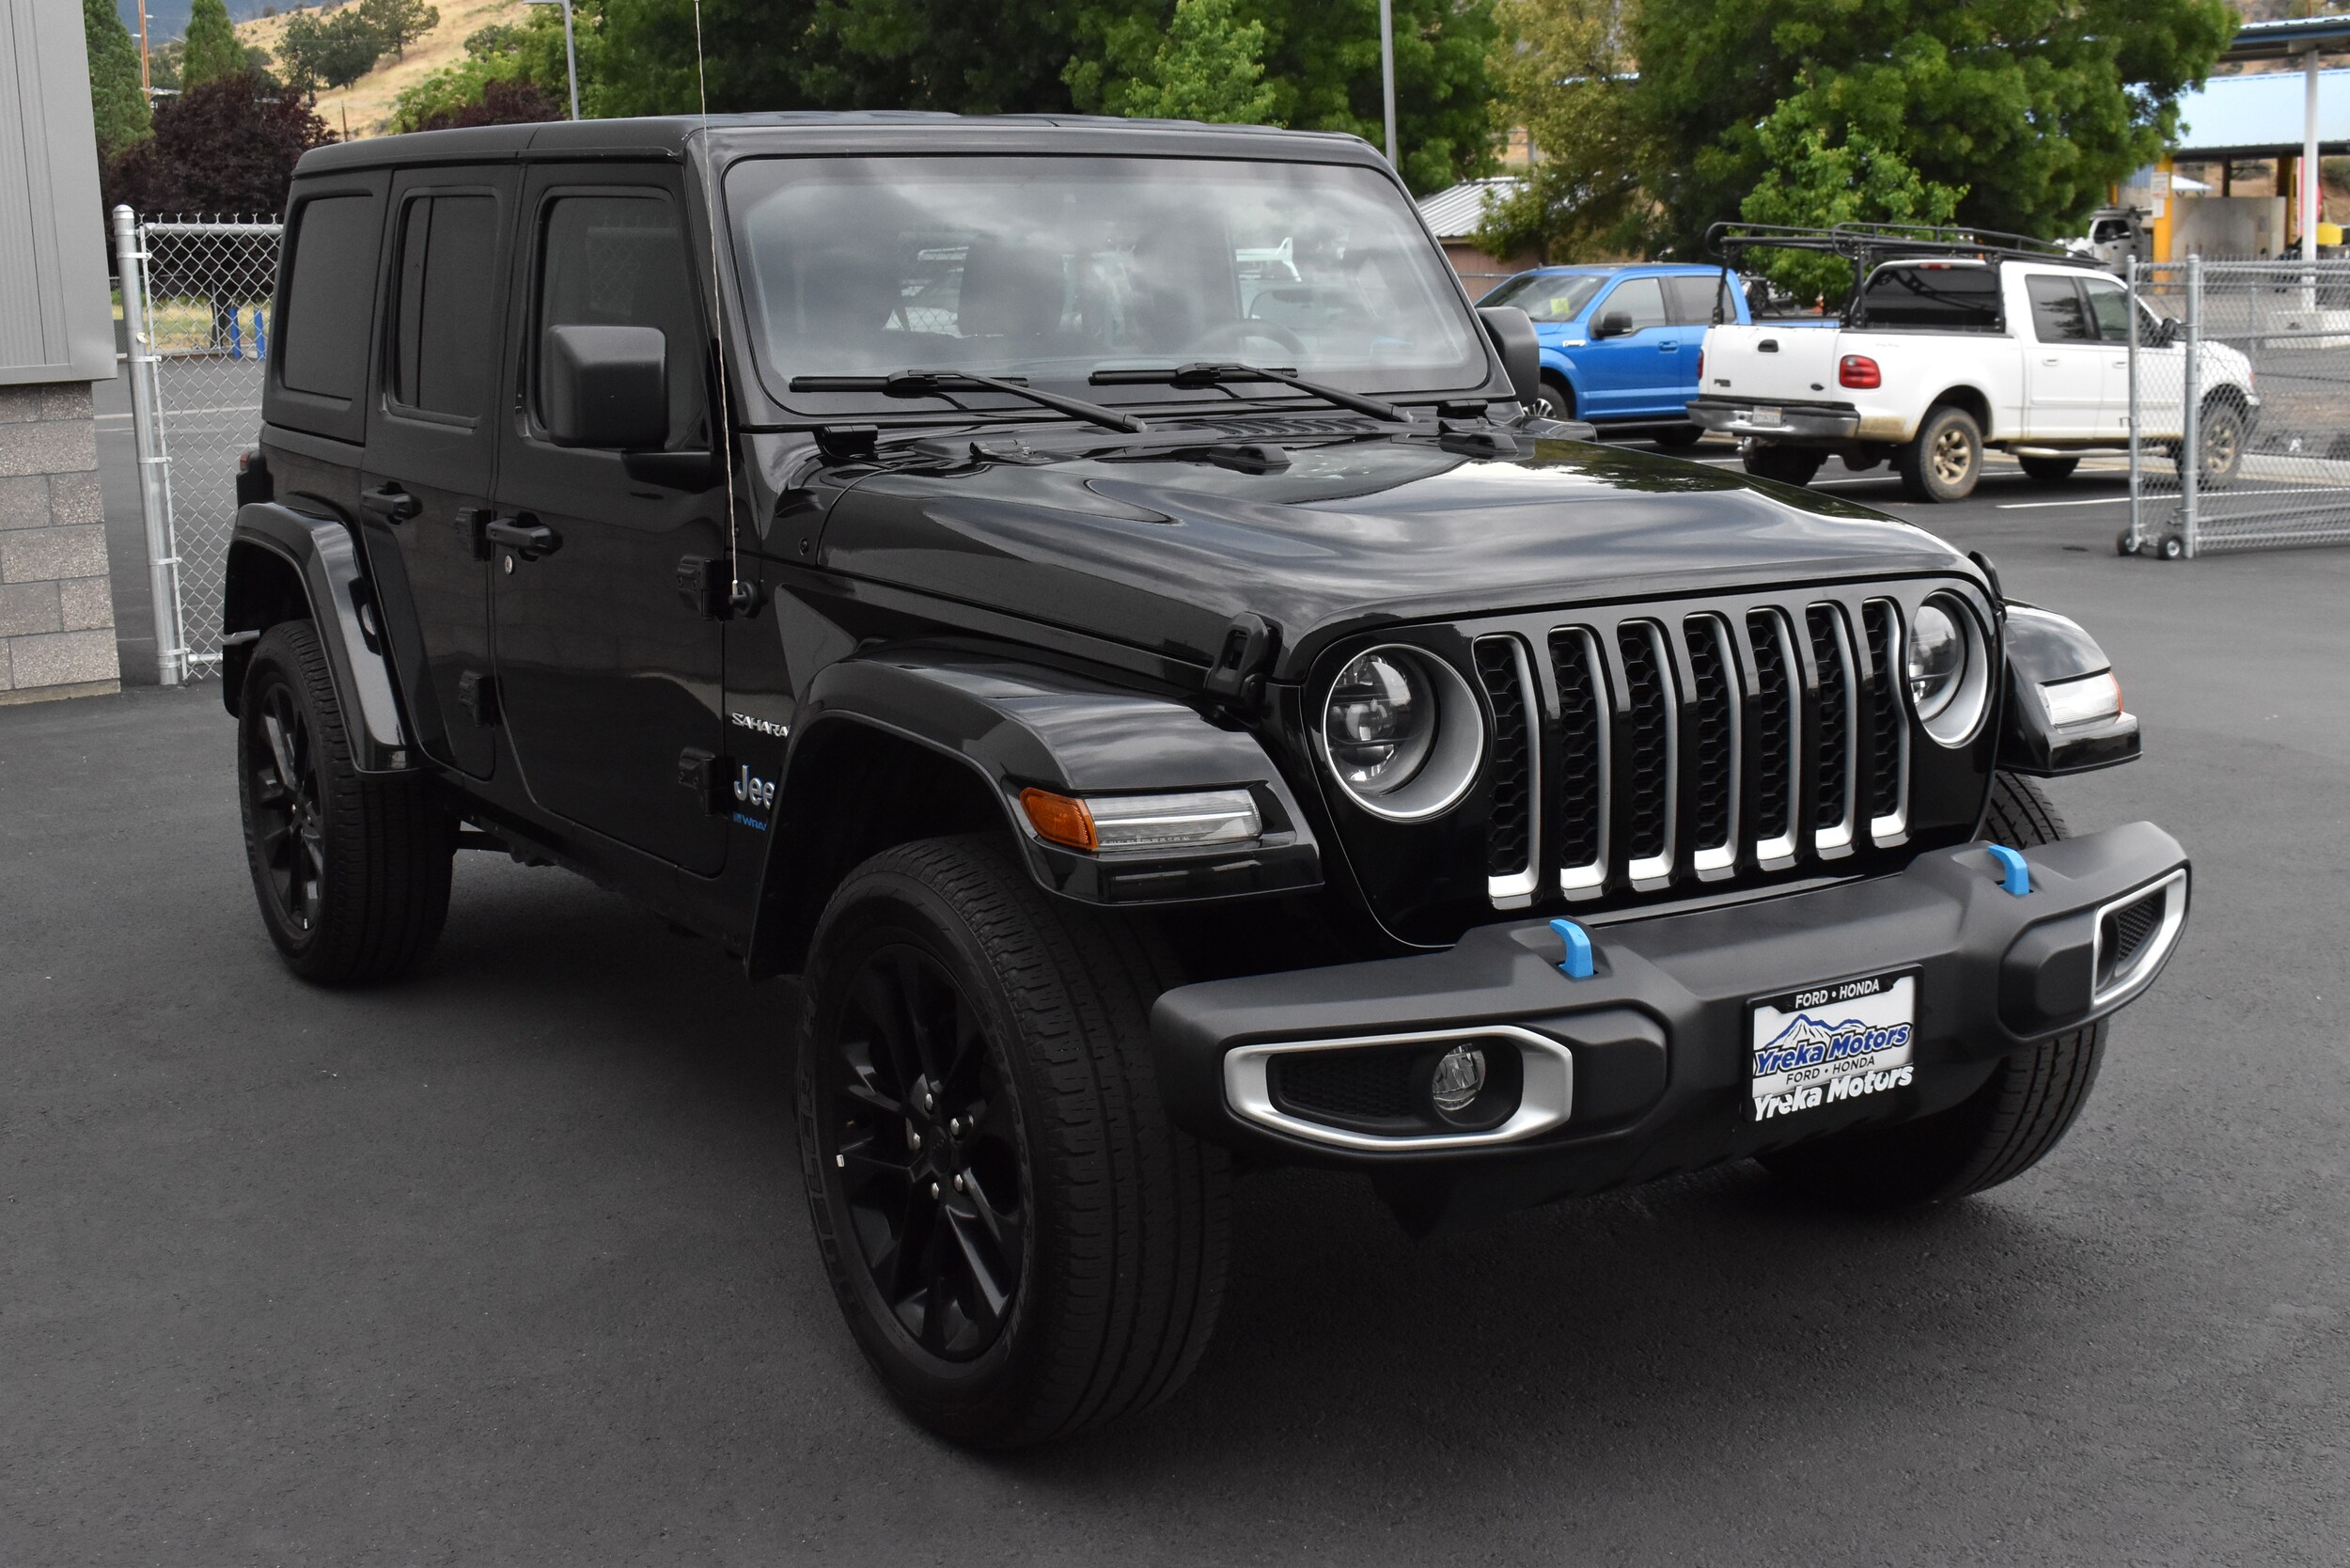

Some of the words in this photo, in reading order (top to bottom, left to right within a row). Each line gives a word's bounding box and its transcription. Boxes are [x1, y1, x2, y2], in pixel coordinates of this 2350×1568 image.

[731, 712, 791, 738] SAHARA
[733, 764, 776, 810] Jee
[1795, 990, 1828, 1009] FORD
[1839, 979, 1880, 999] HONDA
[1755, 1043, 1825, 1074] Yreka
[1828, 1026, 1910, 1059] Motors
[1785, 1068, 1821, 1085] FORD
[1832, 1056, 1875, 1074] HONDA
[1754, 1085, 1824, 1121] Yreka
[1826, 1065, 1915, 1104] Motors
